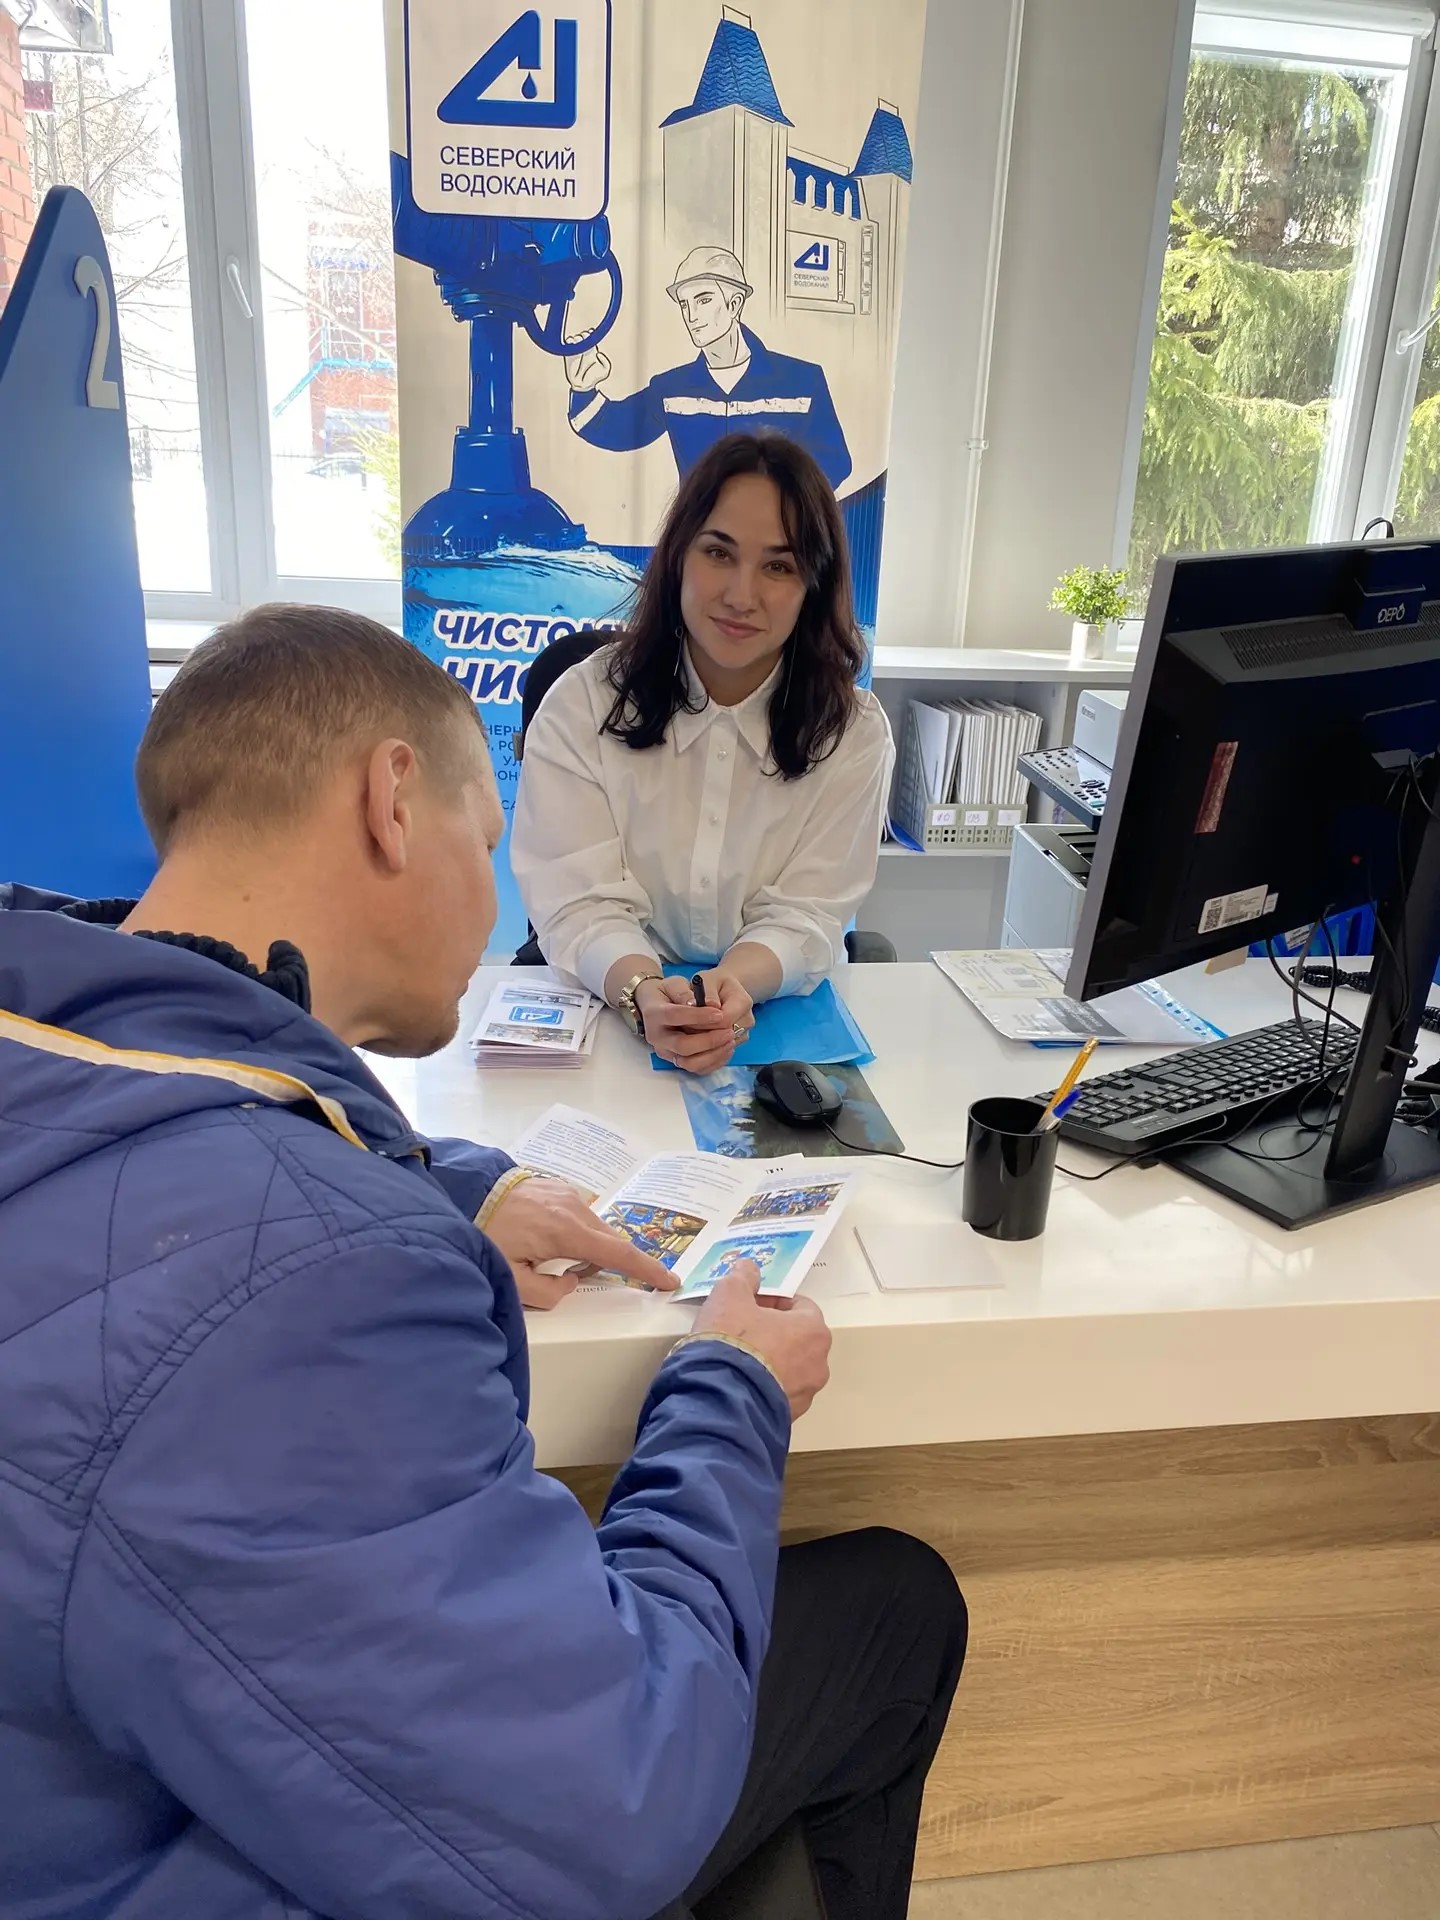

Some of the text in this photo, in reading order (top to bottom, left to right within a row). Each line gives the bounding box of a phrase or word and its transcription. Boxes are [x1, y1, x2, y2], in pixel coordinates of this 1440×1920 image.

[440, 145, 576, 171] СЕВЕРСКИЙ
[440, 173, 576, 198] ВОДОКАНАЛ
[73, 255, 120, 409] 2
[1377, 602, 1405, 623] DEPO
